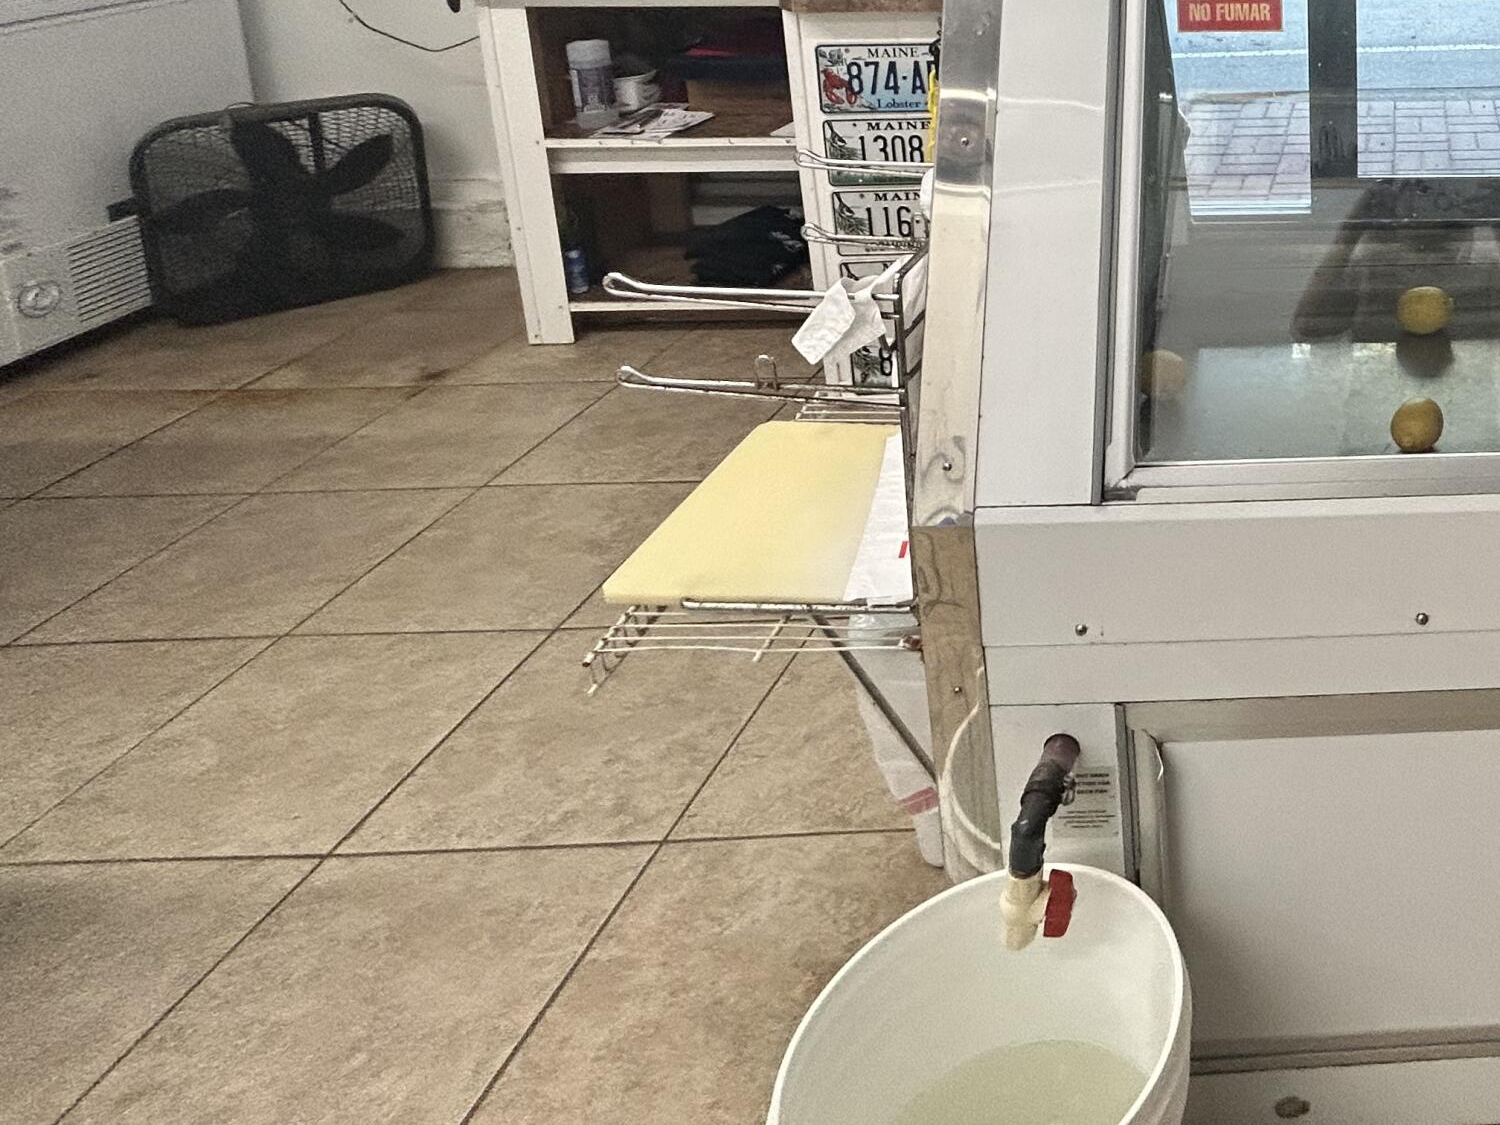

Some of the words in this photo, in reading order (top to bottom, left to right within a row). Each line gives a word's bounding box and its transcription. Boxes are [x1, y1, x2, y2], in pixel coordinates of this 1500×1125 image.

[1189, 3, 1211, 22] NO
[1216, 3, 1271, 22] FUMAR
[867, 46, 920, 58] MAINE
[877, 98, 921, 109] Lobster
[866, 121, 931, 131] MAINE
[858, 134, 925, 163] 1308
[874, 192, 921, 202] MAIN
